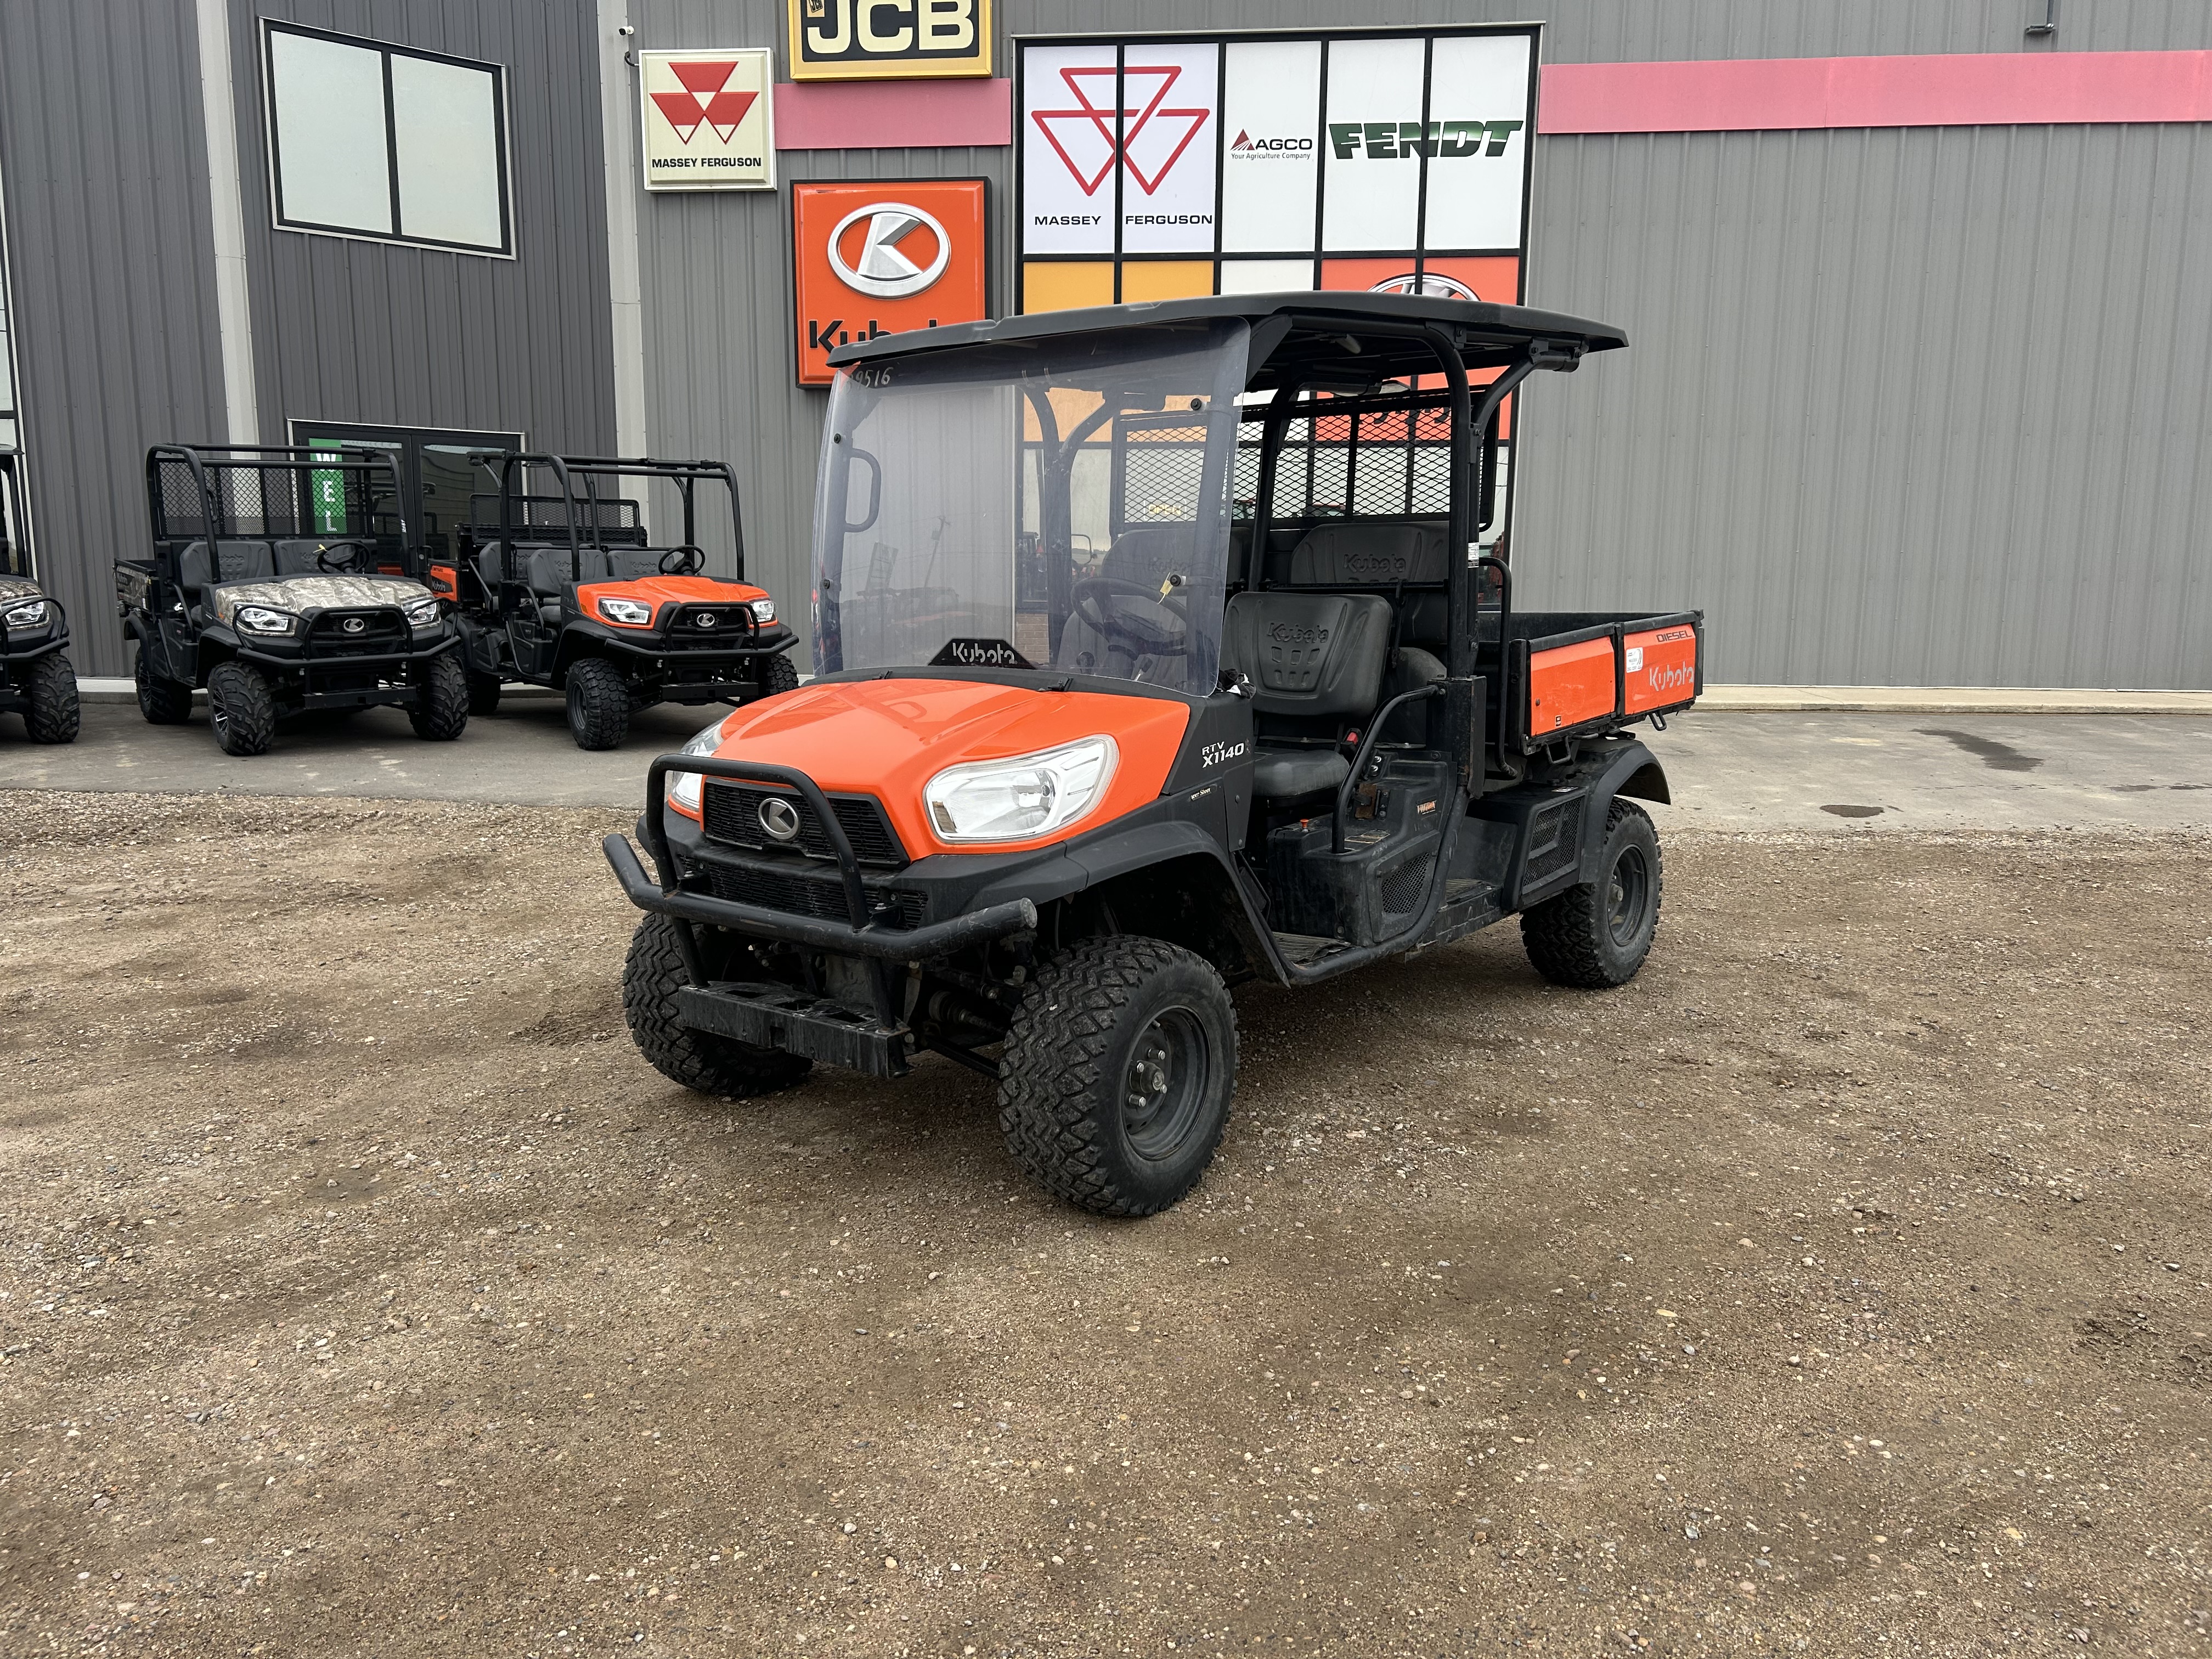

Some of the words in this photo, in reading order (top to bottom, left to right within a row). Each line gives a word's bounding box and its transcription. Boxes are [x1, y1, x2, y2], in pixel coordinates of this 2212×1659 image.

[807, 0, 974, 54] JCB
[1255, 139, 1312, 150] AGCO
[1329, 120, 1523, 159] FENDT
[652, 158, 698, 168] MASSEY
[701, 157, 761, 167] FERGUSON
[1035, 216, 1101, 225] MASSEY
[1125, 215, 1212, 224] FERGUSON
[1656, 630, 1692, 642] DIESEL
[952, 642, 1015, 664] Kubota
[1649, 661, 1694, 691] Kubota
[1201, 741, 1224, 755] RTV
[1202, 743, 1244, 768] X1140
